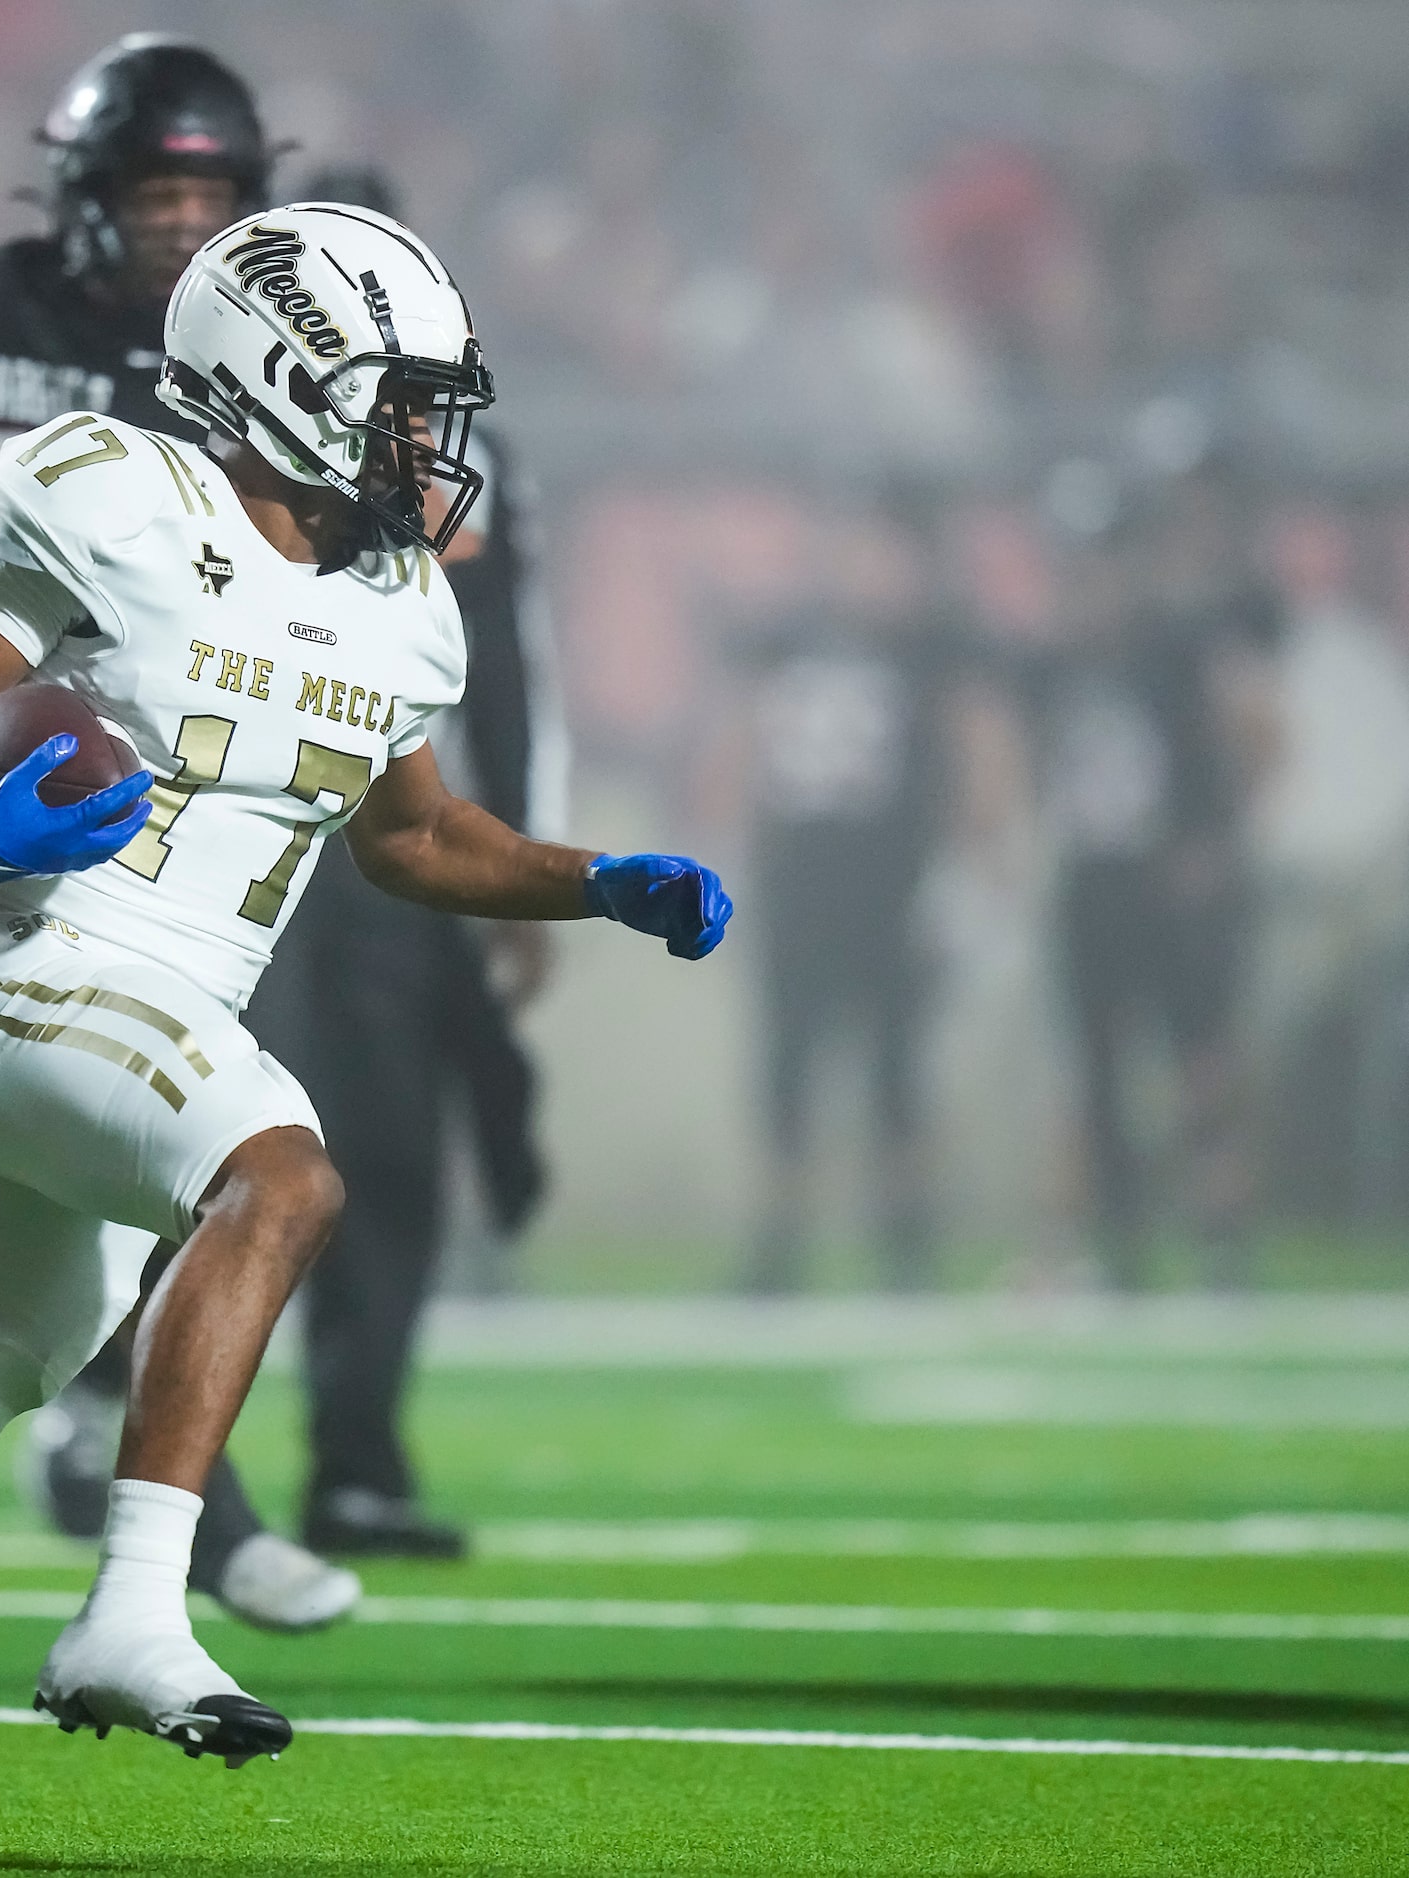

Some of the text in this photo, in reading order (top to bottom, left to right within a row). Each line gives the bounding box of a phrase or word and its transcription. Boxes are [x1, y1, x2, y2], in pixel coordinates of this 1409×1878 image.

[223, 225, 349, 362] Mecca
[16, 415, 129, 488] 17
[293, 625, 333, 642] BATTLE
[187, 640, 274, 701] THE
[110, 714, 373, 929] 17
